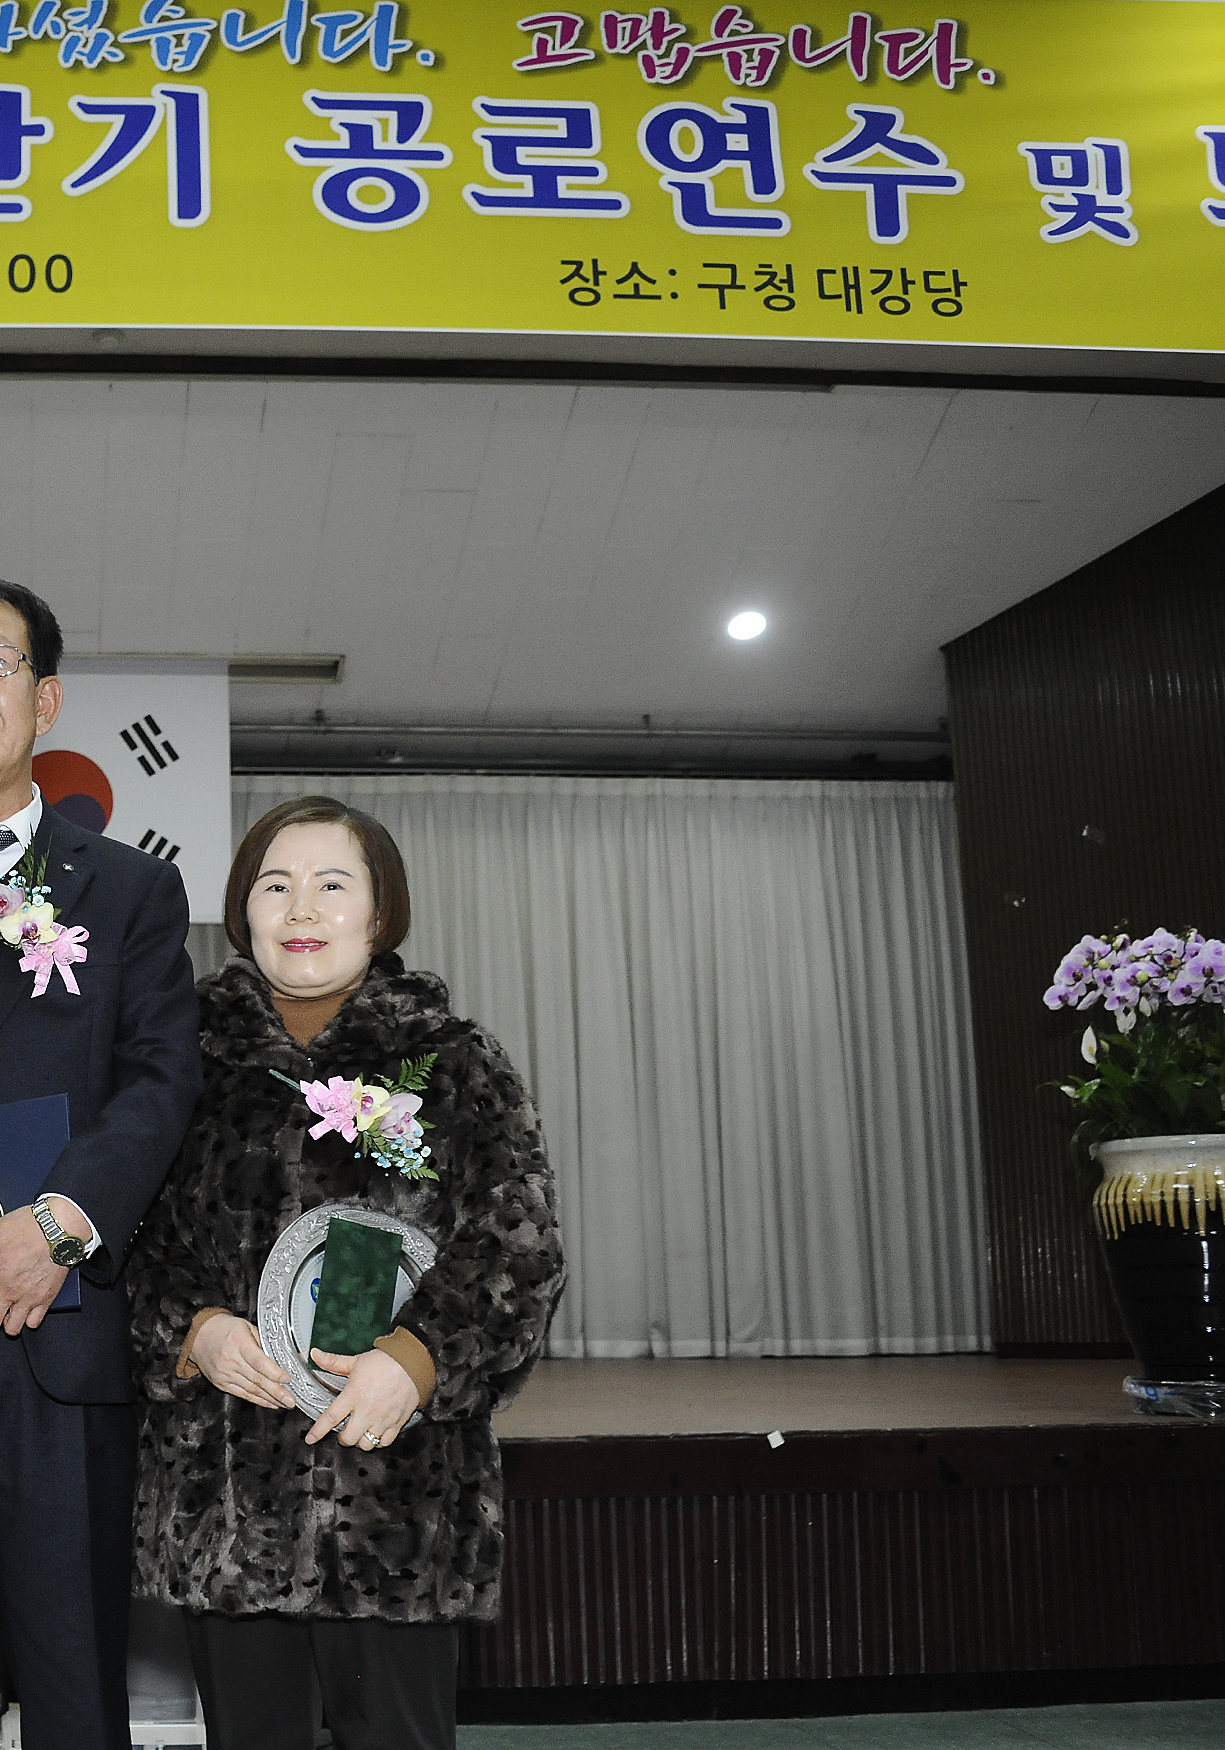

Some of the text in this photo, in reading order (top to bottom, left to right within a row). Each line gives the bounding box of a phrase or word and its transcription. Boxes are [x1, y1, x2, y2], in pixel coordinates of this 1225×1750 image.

[513, 5, 997, 89] 고맙습니다.
[285, 89, 965, 244] 공로연수
[1018, 137, 1139, 246] 및
[559, 258, 968, 318] 장소: 구청 대강당
